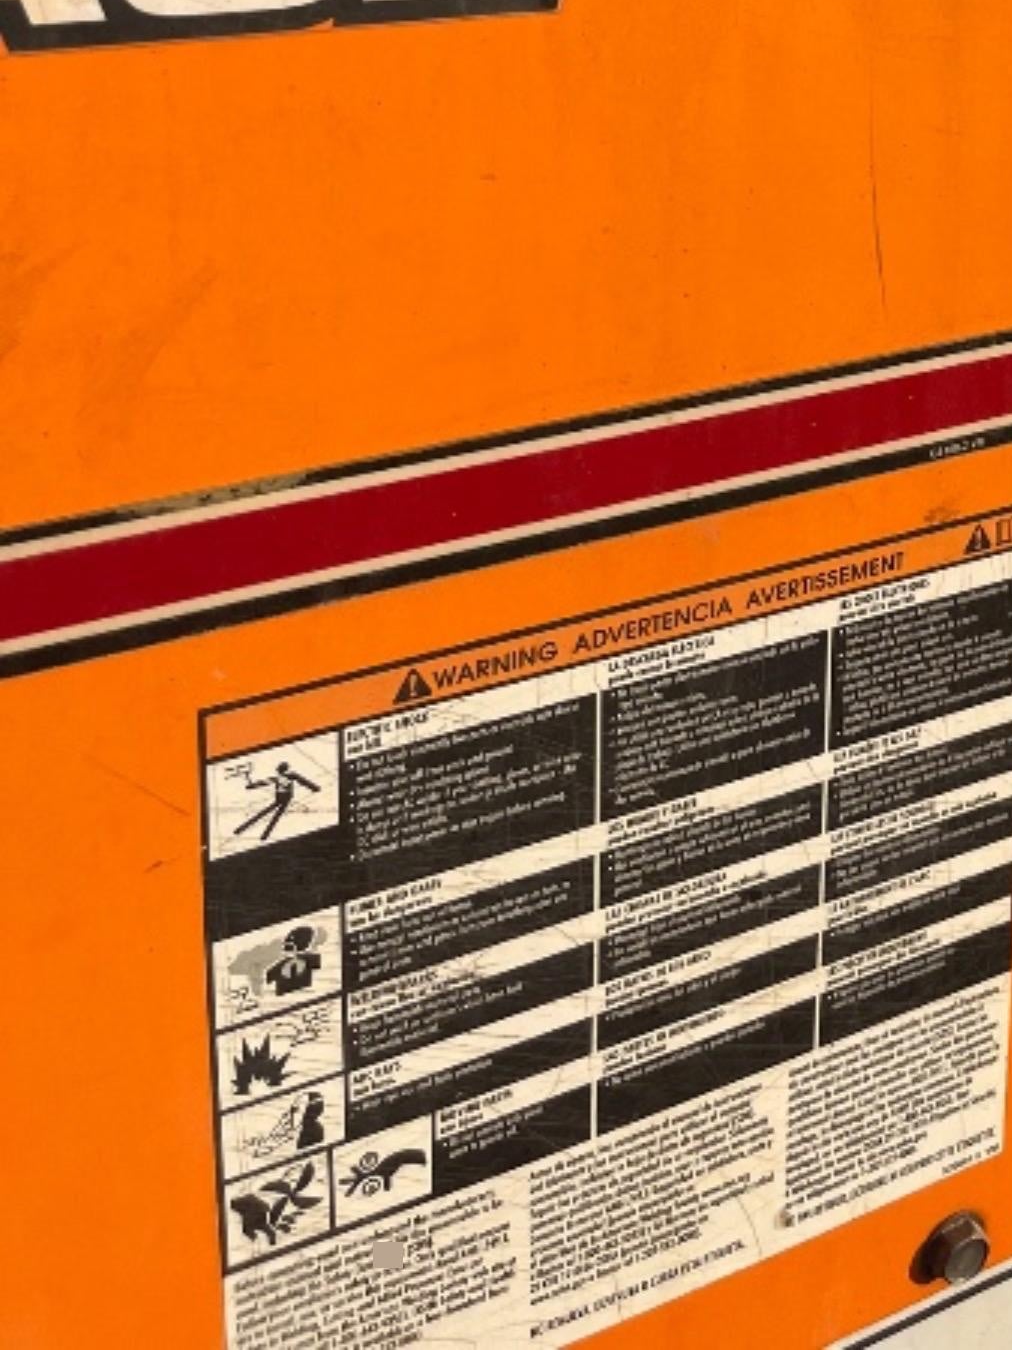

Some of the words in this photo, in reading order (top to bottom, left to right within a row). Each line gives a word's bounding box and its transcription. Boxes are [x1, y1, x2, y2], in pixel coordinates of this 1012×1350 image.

[432, 641, 558, 690] WARNING
[572, 596, 732, 654] ADVERTENCIA
[745, 552, 904, 609] AVERTISSEMENT
